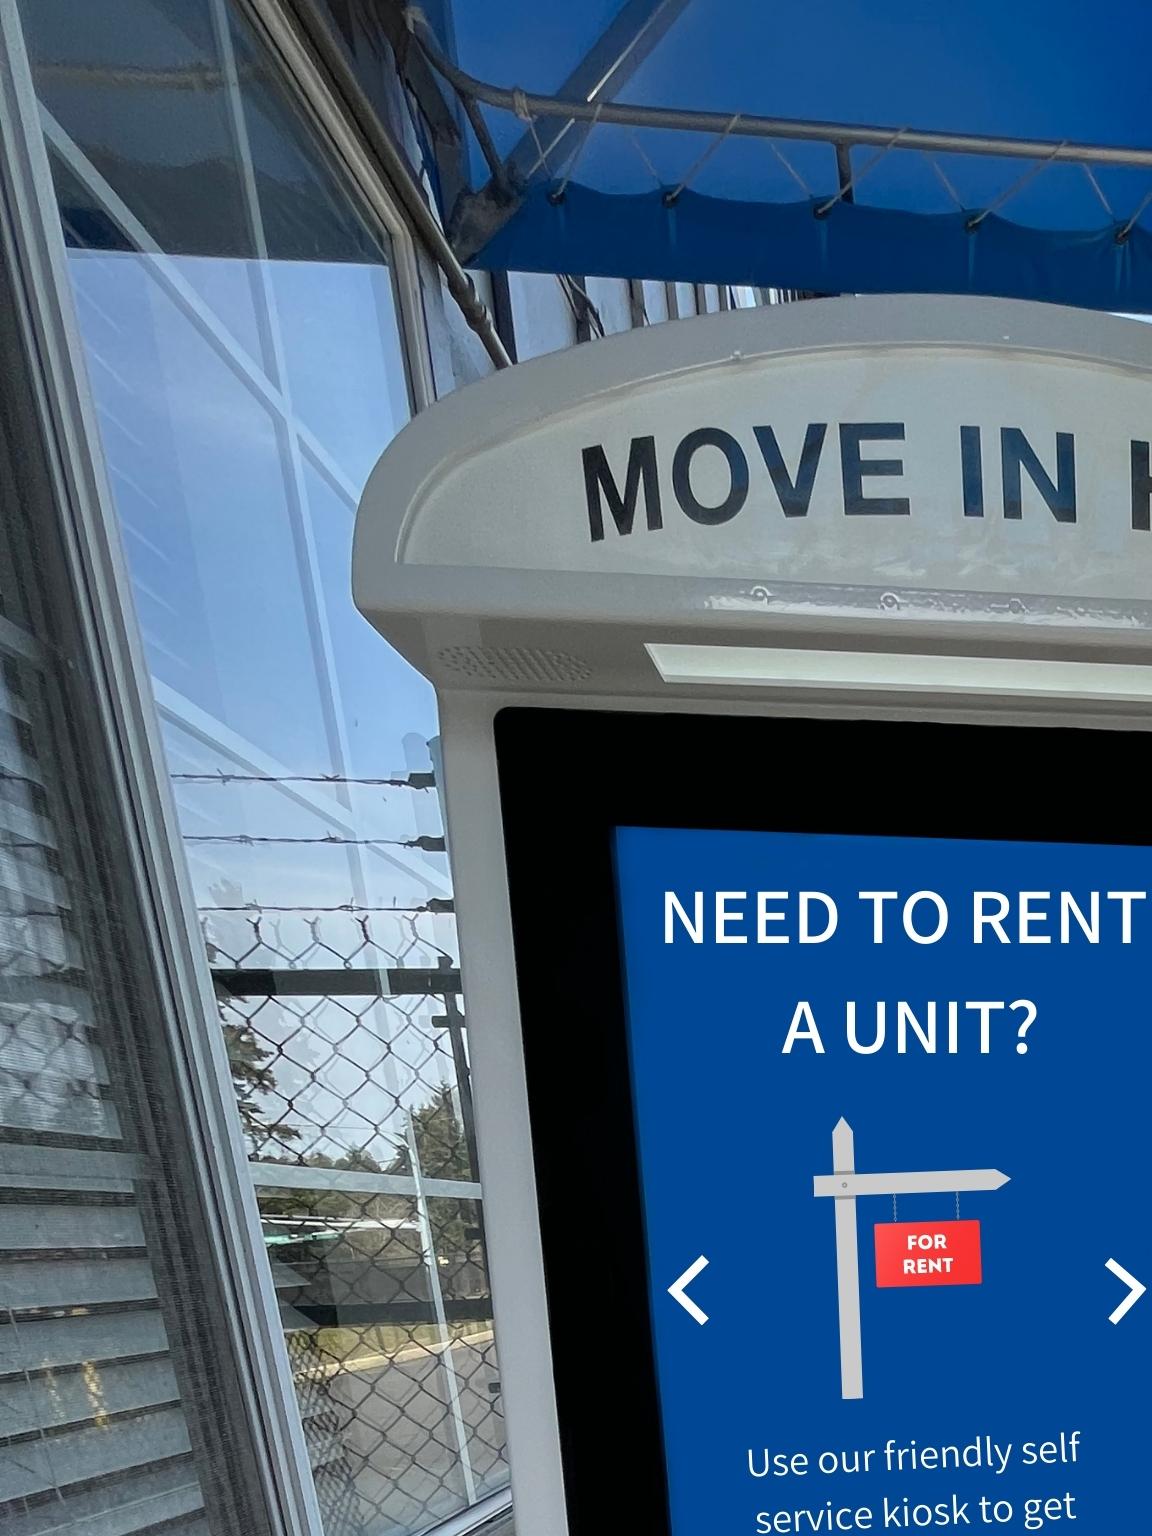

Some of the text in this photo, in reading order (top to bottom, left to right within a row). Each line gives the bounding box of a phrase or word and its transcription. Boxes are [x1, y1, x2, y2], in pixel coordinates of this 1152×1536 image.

[581, 422, 911, 542] MOVE
[960, 425, 1077, 524] IN
[664, 890, 1147, 945] NEED TO RENT
[781, 999, 1038, 1055] A UNIT?
[903, 1257, 954, 1274] RENT
[906, 1234, 948, 1251] FOR
[748, 1431, 1082, 1478] Use our friendly self
[756, 1492, 1078, 1534] service kiosk to get
